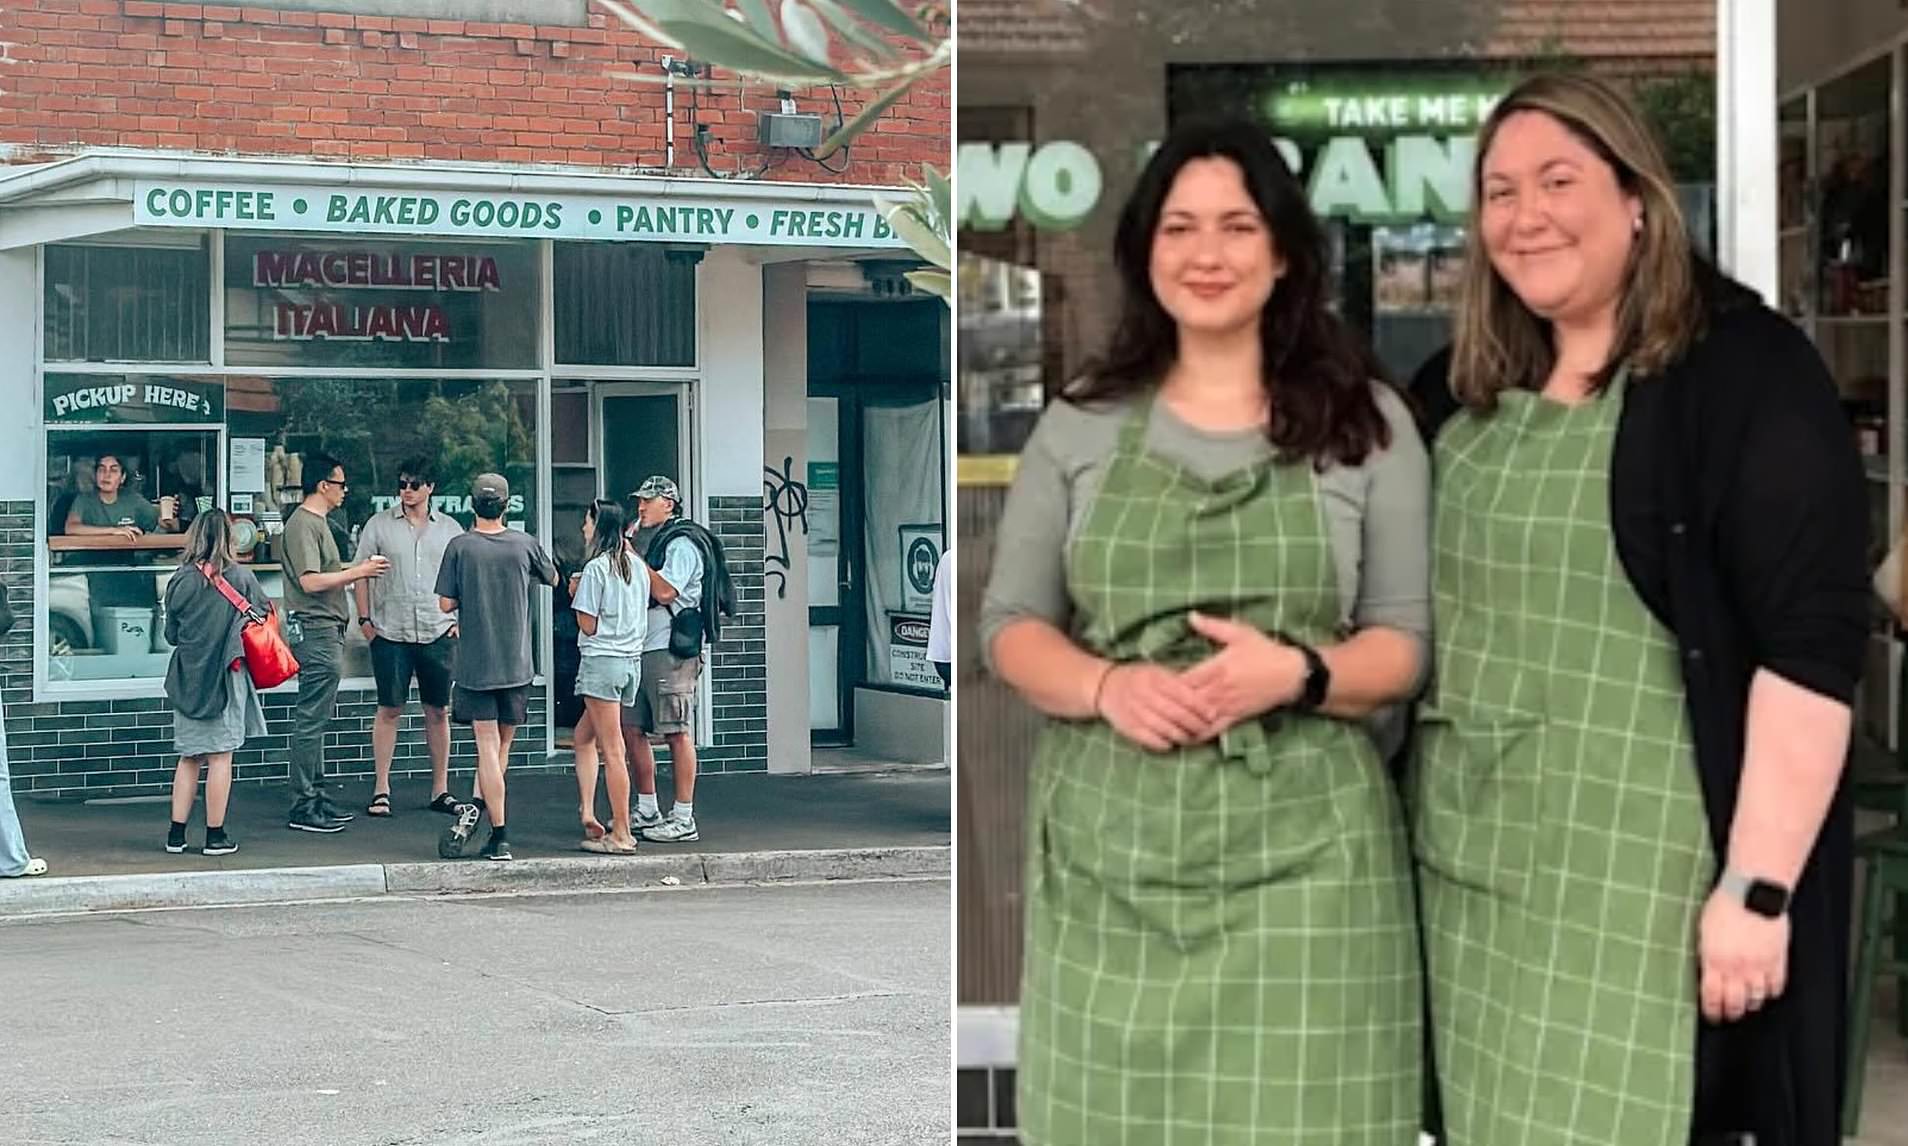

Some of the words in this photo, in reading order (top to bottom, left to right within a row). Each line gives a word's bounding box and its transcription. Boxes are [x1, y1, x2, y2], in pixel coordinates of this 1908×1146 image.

[1323, 97, 1408, 127] TAKE
[1419, 97, 1467, 127] ME
[147, 188, 275, 220] COFFEE
[327, 194, 439, 225] BAKED
[450, 199, 563, 229] GOODS
[616, 205, 735, 235] PANTRY
[769, 210, 864, 238] FRESH
[873, 213, 899, 239] B
[253, 251, 500, 292] MACELLERIA
[273, 303, 449, 343] ITALIANA
[52, 384, 136, 416] PICKUP
[144, 384, 200, 411] HERE
[901, 625, 929, 638] DANGE
